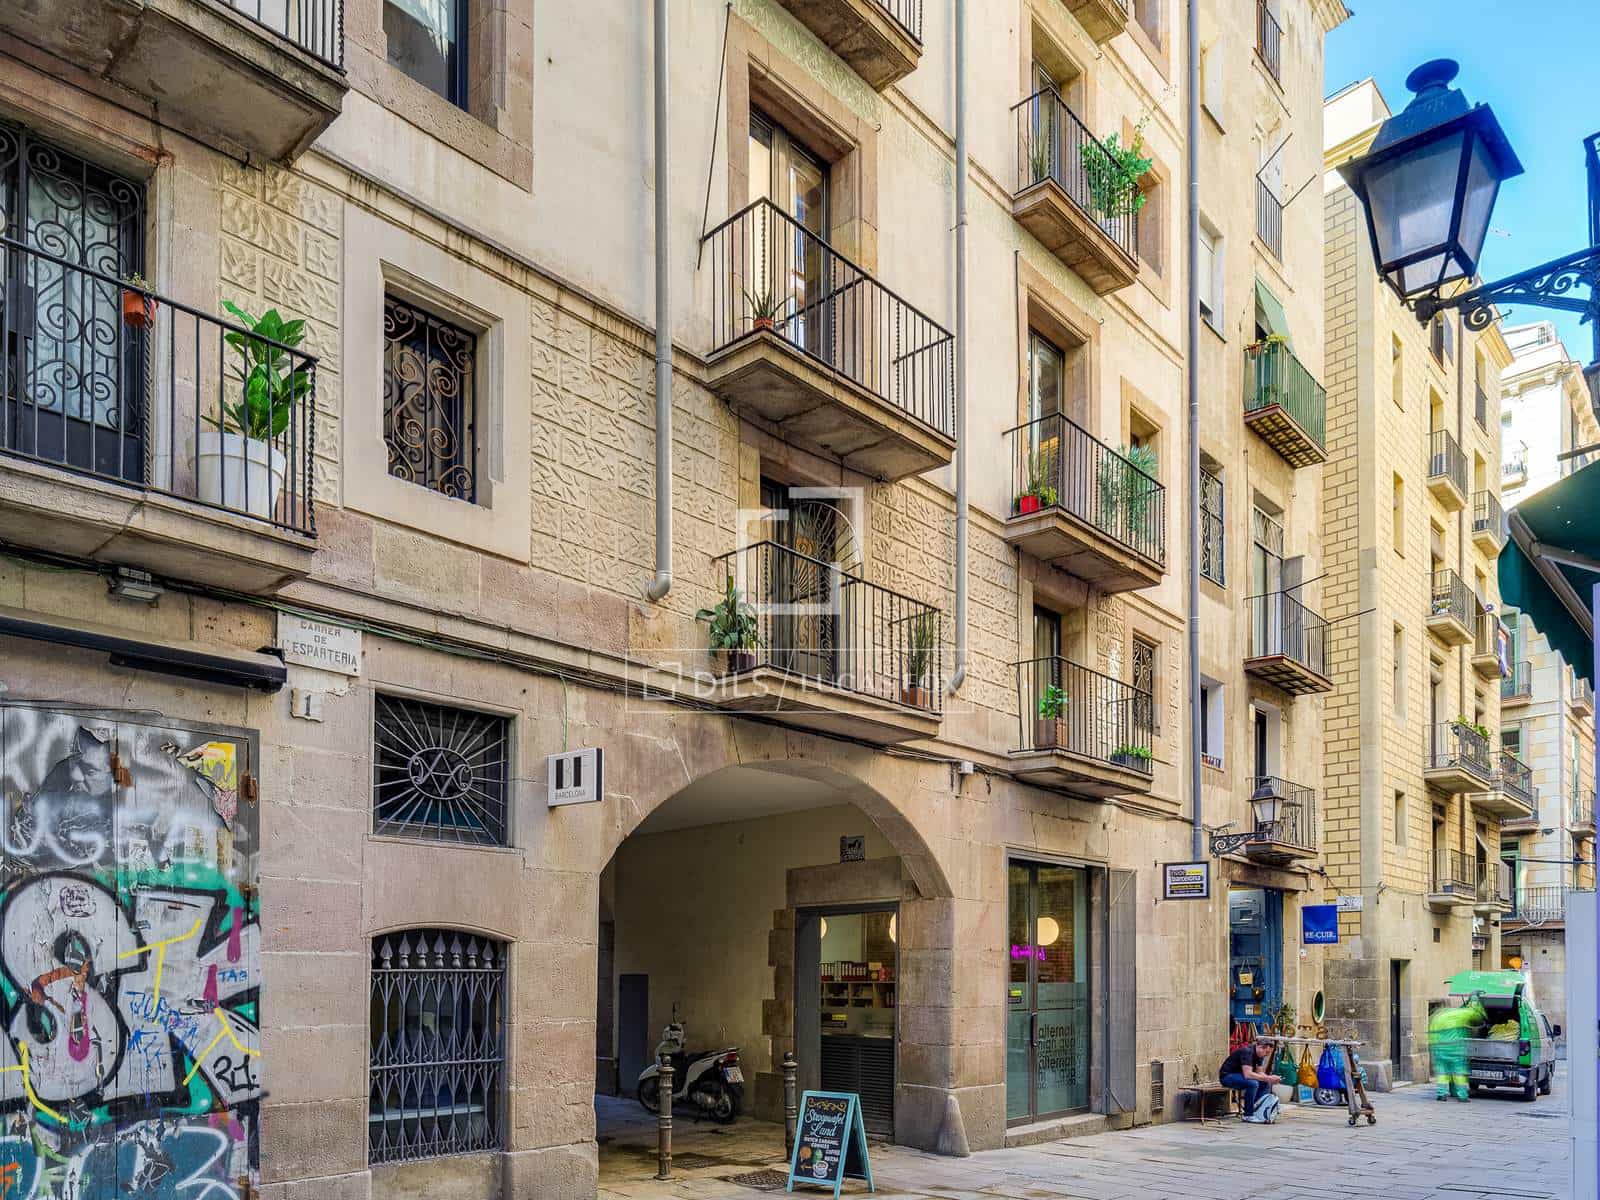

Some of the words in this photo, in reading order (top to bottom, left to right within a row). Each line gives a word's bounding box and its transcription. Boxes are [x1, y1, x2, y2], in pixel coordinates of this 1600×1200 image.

[300, 620, 341, 637] CARRER
[313, 634, 328, 645] DE
[811, 1122, 836, 1138] Land
